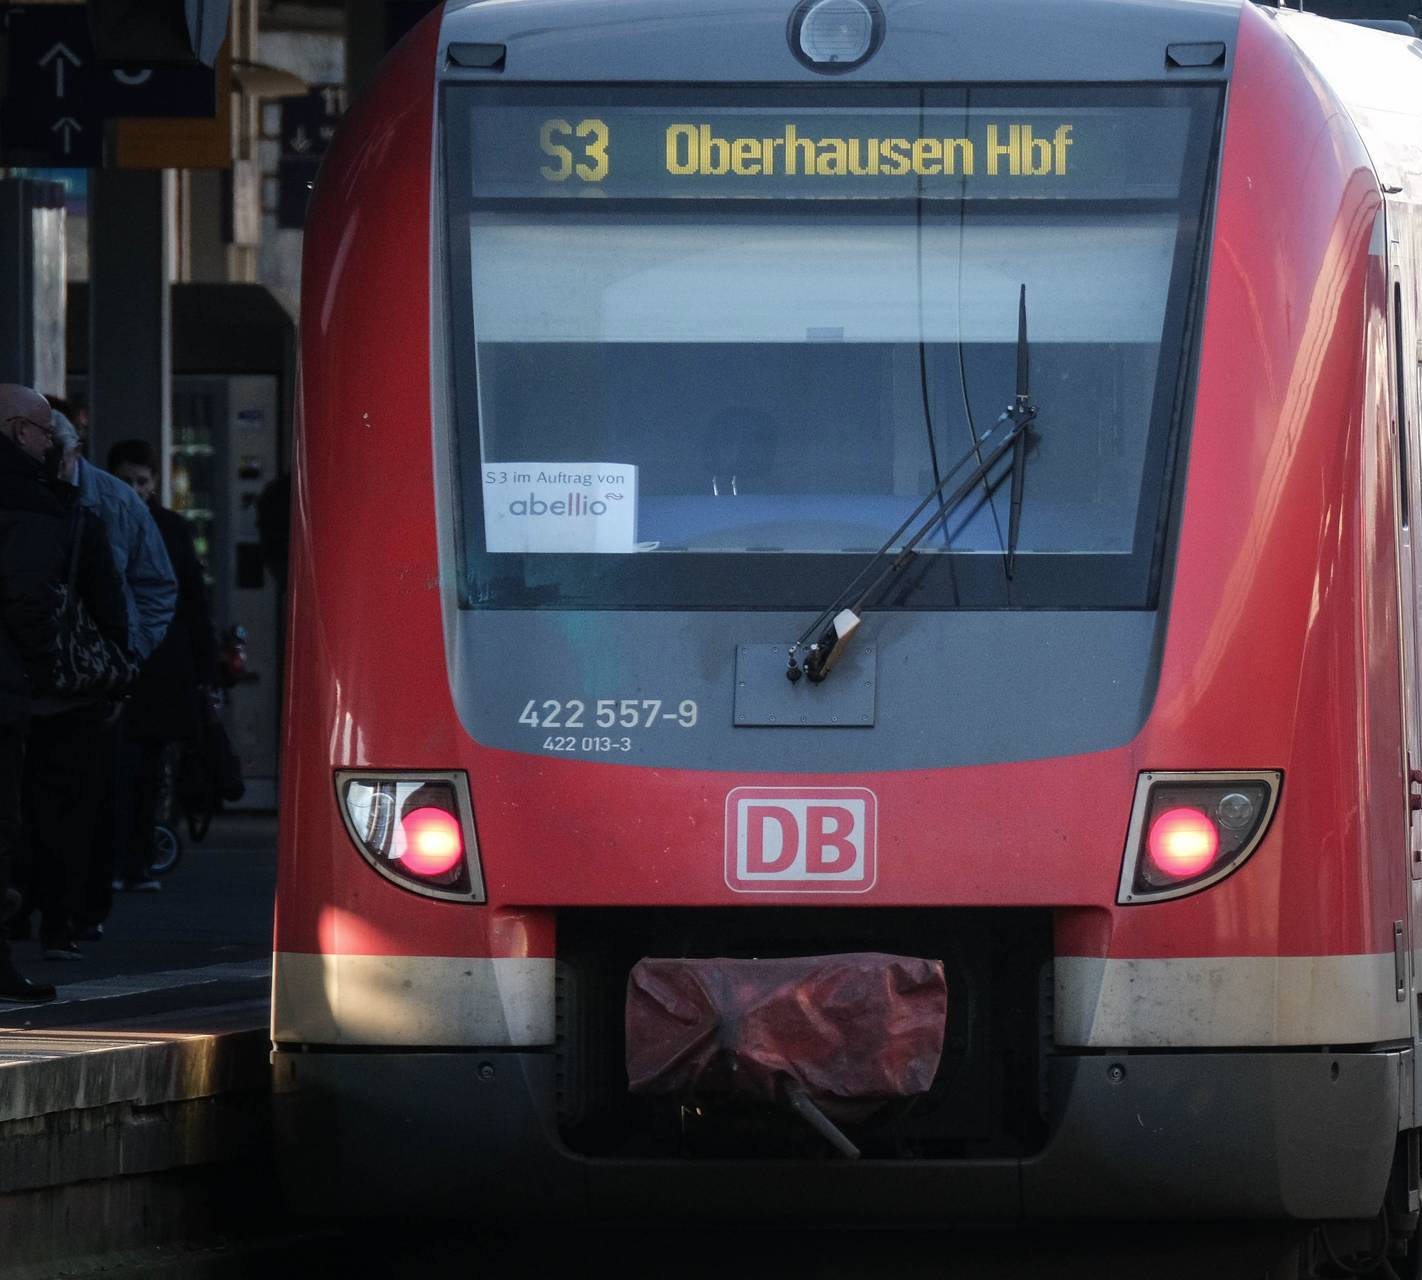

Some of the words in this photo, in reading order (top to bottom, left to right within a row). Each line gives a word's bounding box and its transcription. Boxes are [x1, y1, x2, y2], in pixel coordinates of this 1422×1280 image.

[539, 118, 609, 182] S3
[666, 124, 973, 176] Oberhausen
[986, 124, 1073, 176] Hbf
[513, 472, 531, 484] im
[537, 471, 592, 487] Auftrag
[597, 474, 625, 484] von
[509, 492, 607, 516] abellio
[518, 699, 585, 728] 422
[596, 699, 698, 728] 557-9
[543, 737, 576, 751] 422
[582, 737, 631, 751] 013-3
[746, 805, 857, 874] DB
